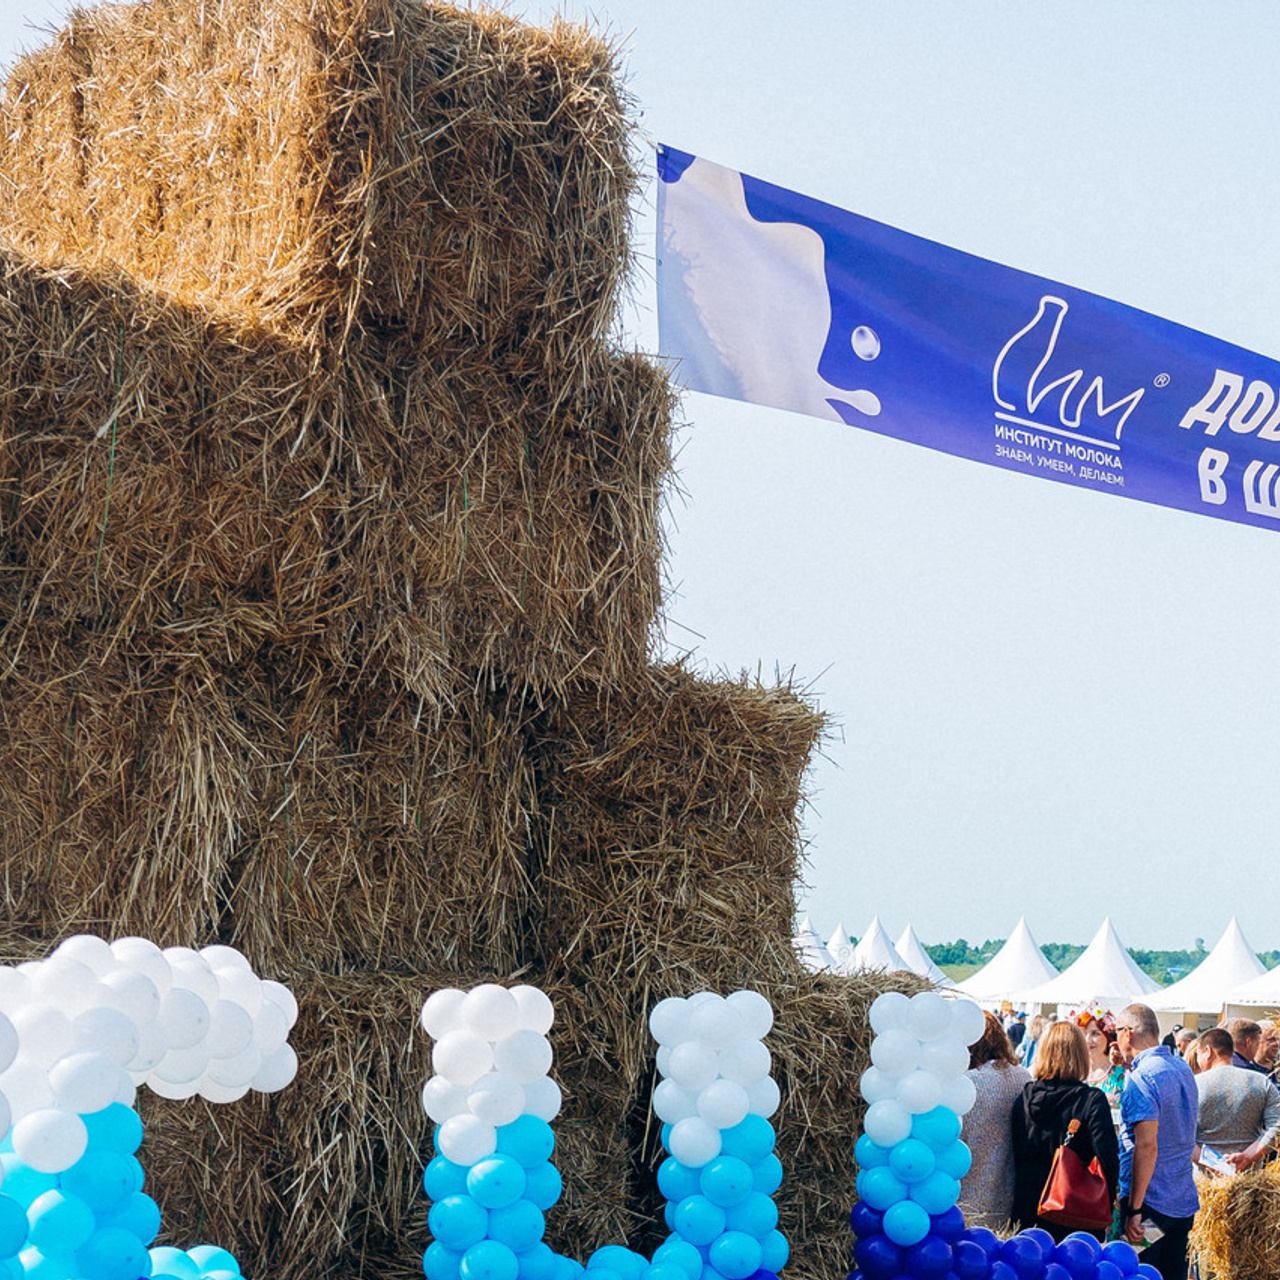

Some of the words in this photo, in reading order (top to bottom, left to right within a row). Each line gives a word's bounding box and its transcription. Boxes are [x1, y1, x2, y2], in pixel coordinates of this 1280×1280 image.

[994, 424, 1063, 454] ИНСТИТУТ
[1065, 442, 1123, 470] МОЛОКА
[994, 444, 1035, 466] ЗНАЕМ,
[1036, 455, 1076, 477] УМЕЕМ,
[1079, 465, 1126, 487] ДЕЛАЕМ!
[1198, 447, 1229, 505] В
